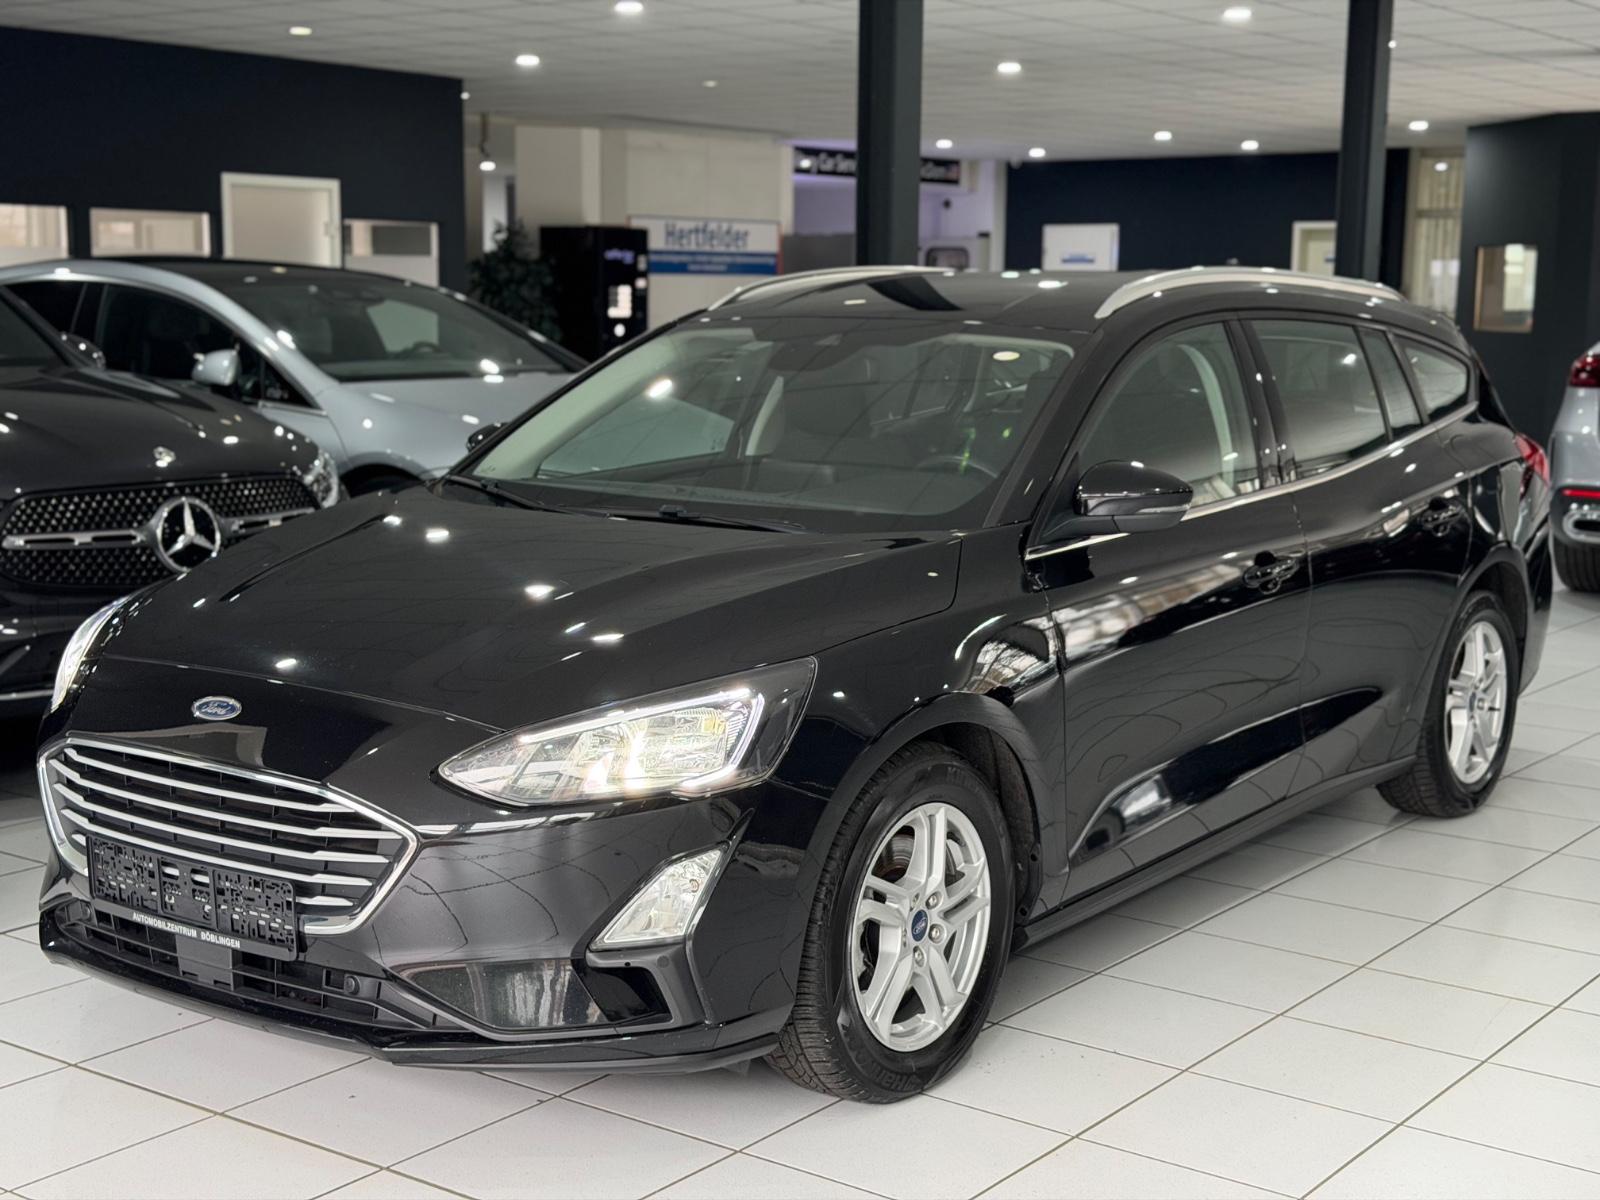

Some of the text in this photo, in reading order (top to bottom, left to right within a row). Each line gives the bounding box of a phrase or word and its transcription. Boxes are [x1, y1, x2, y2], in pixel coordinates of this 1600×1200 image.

[664, 221, 749, 248] Hertfelder
[132, 911, 241, 949] AUTOMOBILZENTRUM BÖBLINGEN
